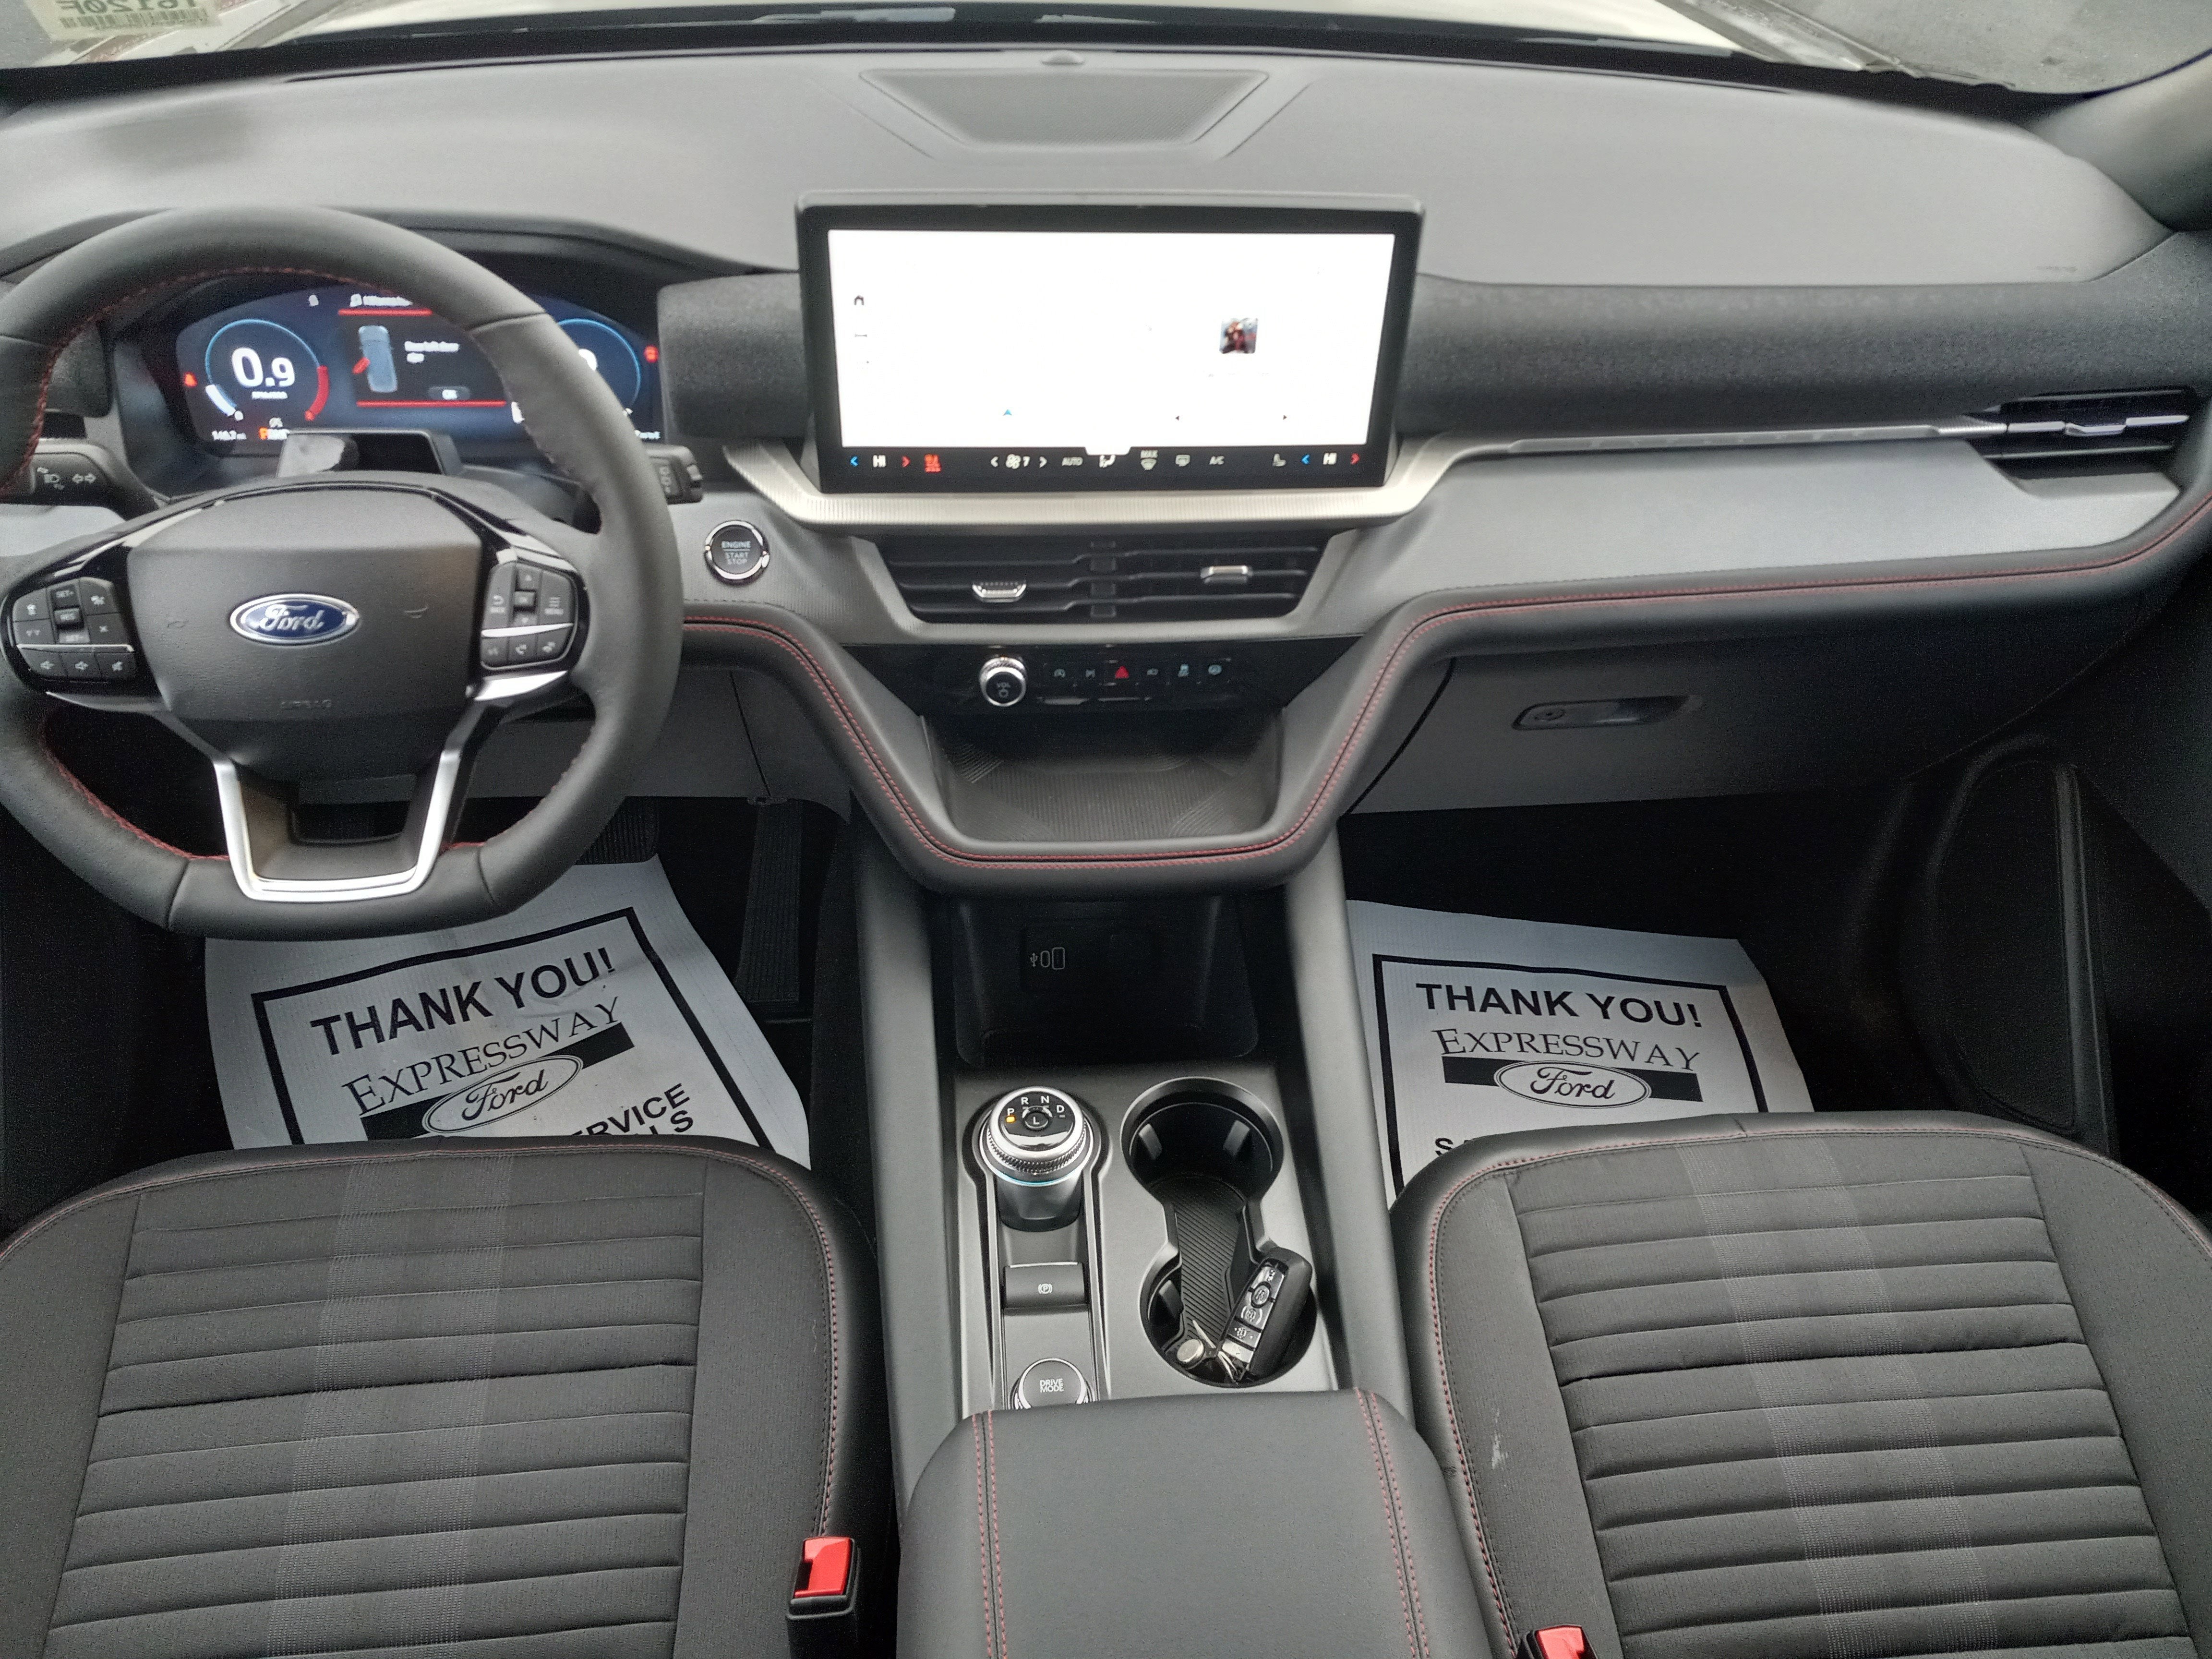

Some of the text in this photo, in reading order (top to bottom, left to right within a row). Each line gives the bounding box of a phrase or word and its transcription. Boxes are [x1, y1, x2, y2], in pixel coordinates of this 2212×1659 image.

[231, 347, 295, 387] 0.9
[1023, 456, 1030, 467] 7
[260, 604, 325, 632] Ford
[310, 947, 616, 1056] THANK YOU!
[1416, 983, 1702, 1027] THANK YOU!
[342, 996, 619, 1116] EXPRESSWAY
[1431, 1028, 1700, 1071] EXPRESSWAY
[461, 1069, 548, 1121] Ford
[1530, 1067, 1615, 1099] Ford
[571, 1082, 691, 1135] RVICE
[1007, 1108, 1015, 1116] P
[1041, 1095, 1050, 1104] N
[1057, 1105, 1065, 1113] D
[1033, 1117, 1040, 1125] L
[1039, 1378, 1063, 1386] DRIVE
[1040, 1384, 1064, 1393] MODE
